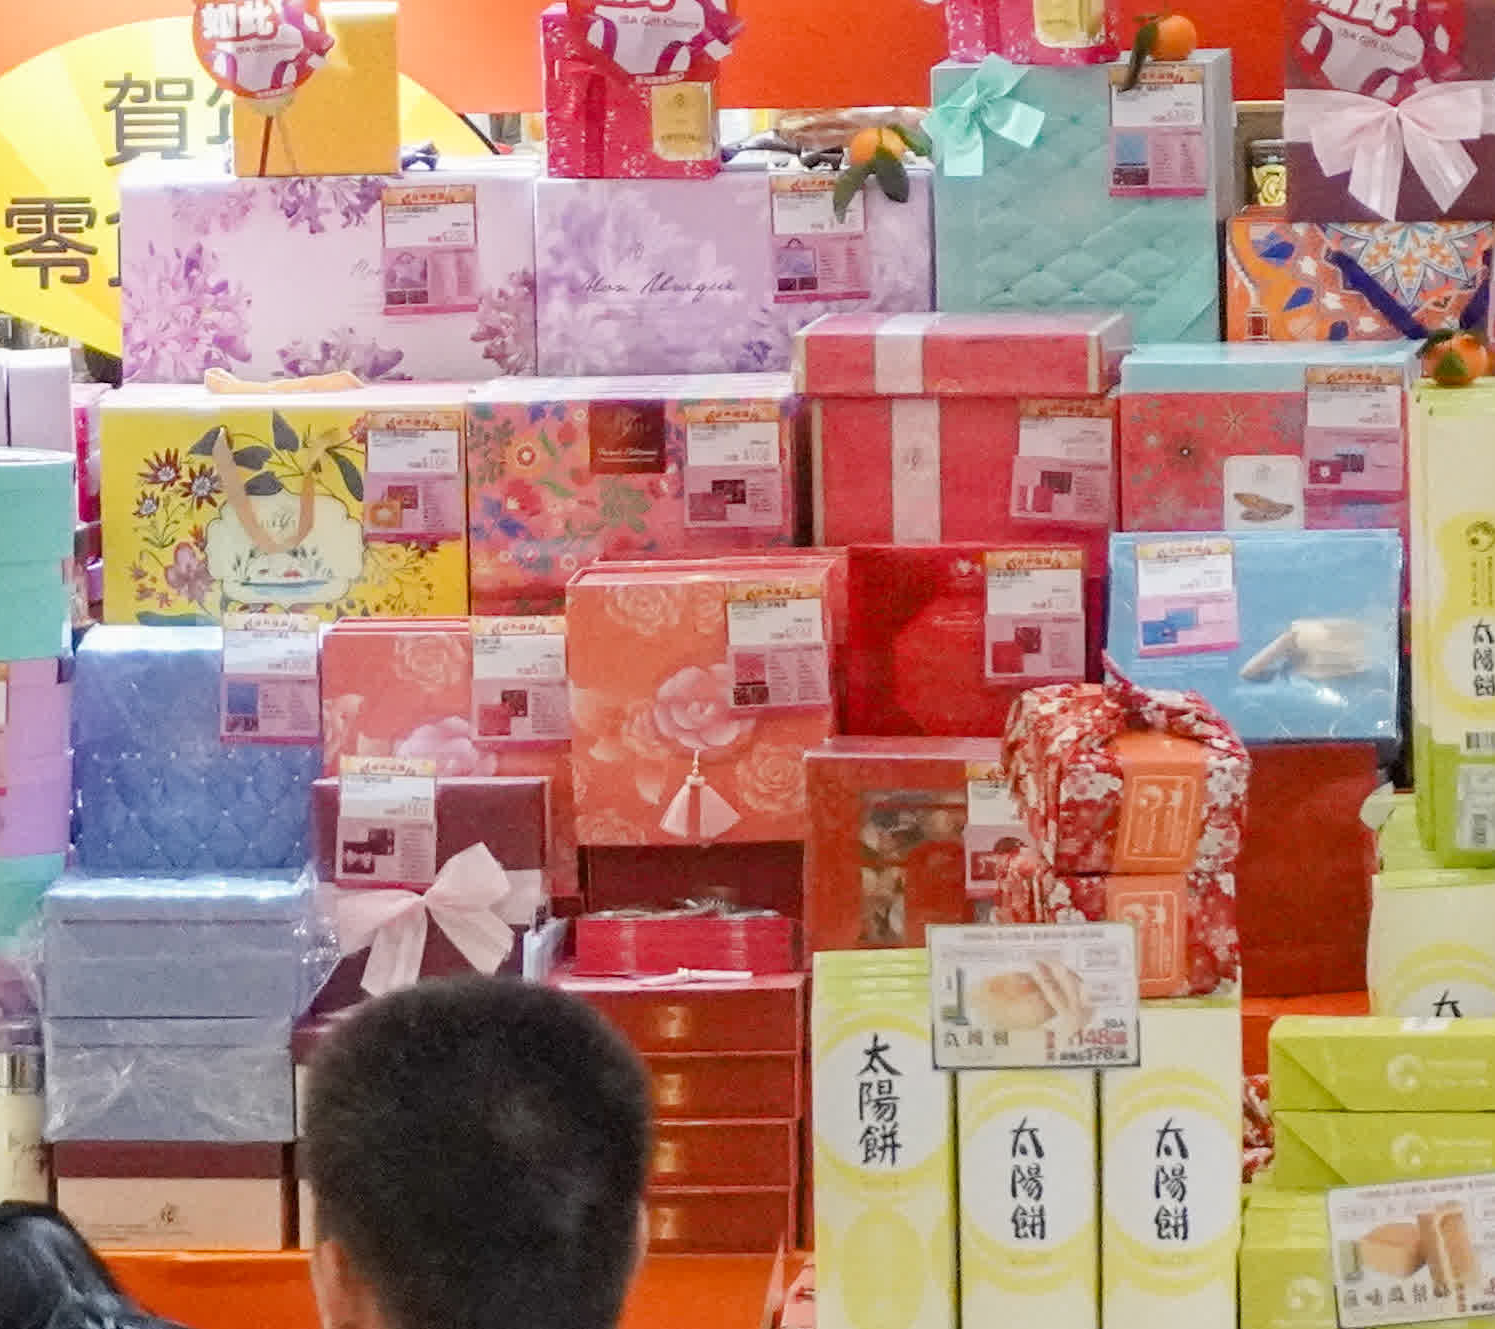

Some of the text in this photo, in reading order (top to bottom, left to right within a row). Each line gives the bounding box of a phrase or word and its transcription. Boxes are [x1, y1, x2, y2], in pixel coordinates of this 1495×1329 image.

[857, 1033, 904, 1167] 太陽餅
[1009, 1114, 1048, 1242] 太陽餅
[1153, 1116, 1191, 1242] 太陽餅
